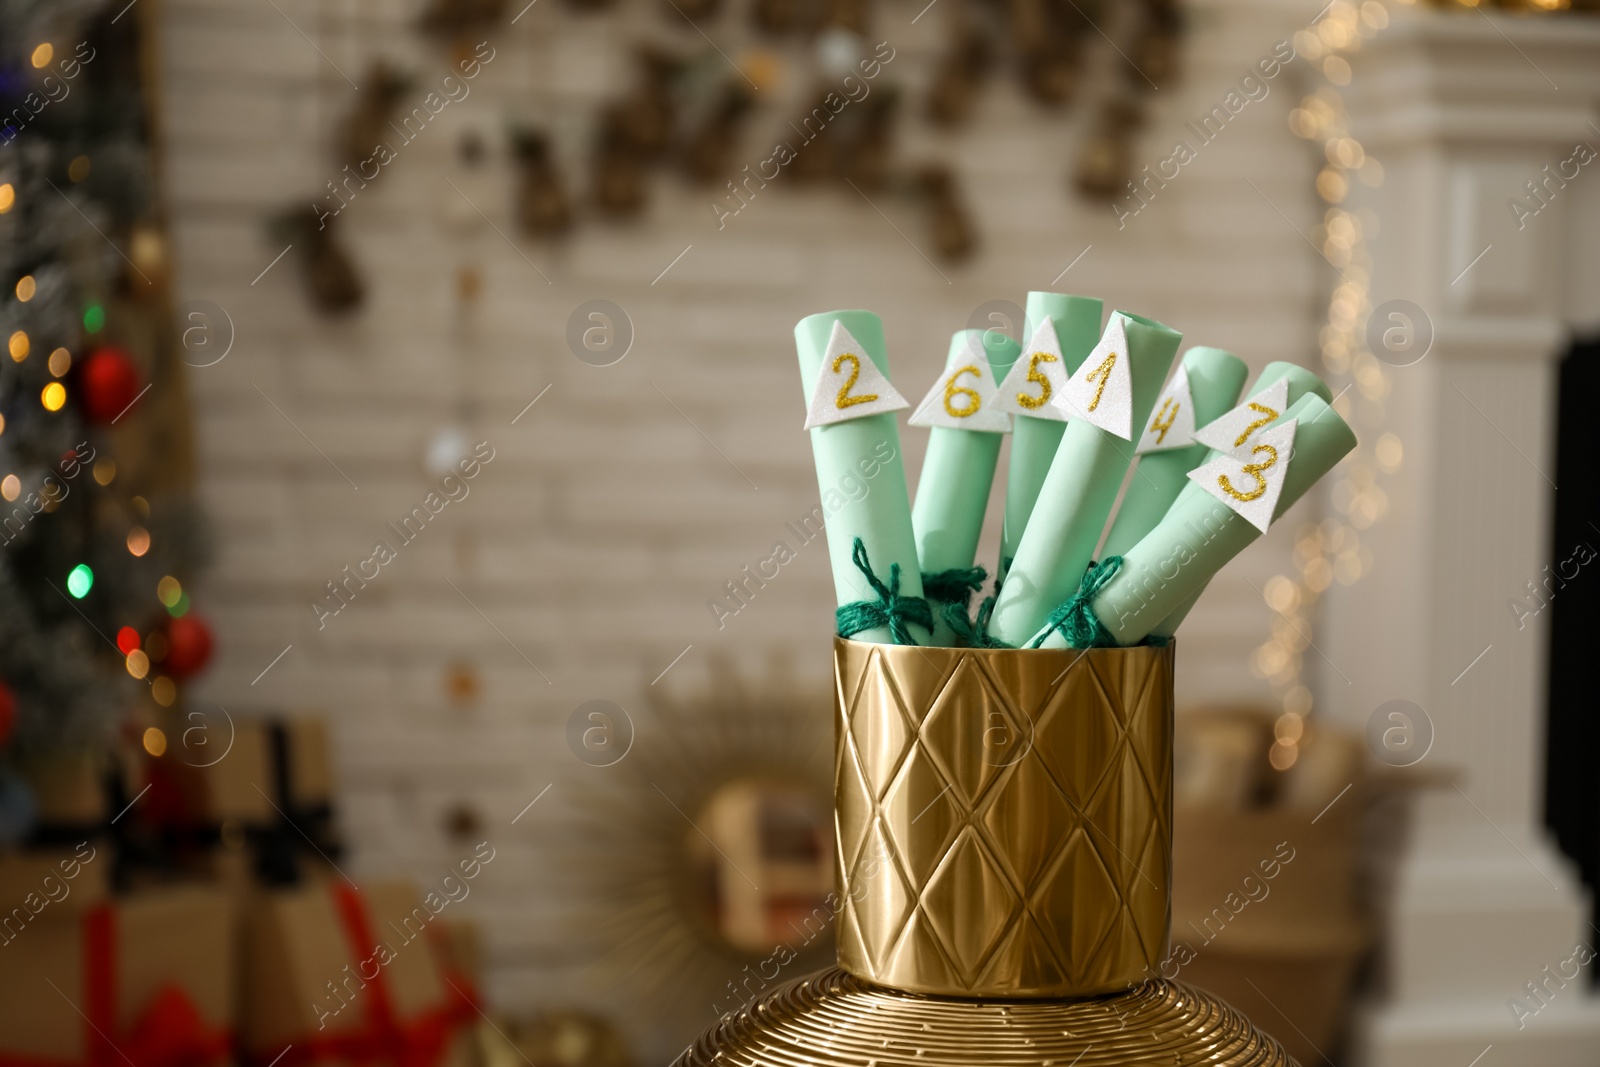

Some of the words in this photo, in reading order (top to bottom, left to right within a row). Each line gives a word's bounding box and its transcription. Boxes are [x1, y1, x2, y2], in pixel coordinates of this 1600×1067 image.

[832, 352, 878, 410] 2
[943, 365, 982, 418] 6
[1016, 351, 1058, 410] 5
[1085, 351, 1117, 413] 1
[1150, 397, 1180, 445] 4
[1234, 402, 1279, 448] 7
[1217, 444, 1278, 502] 3
